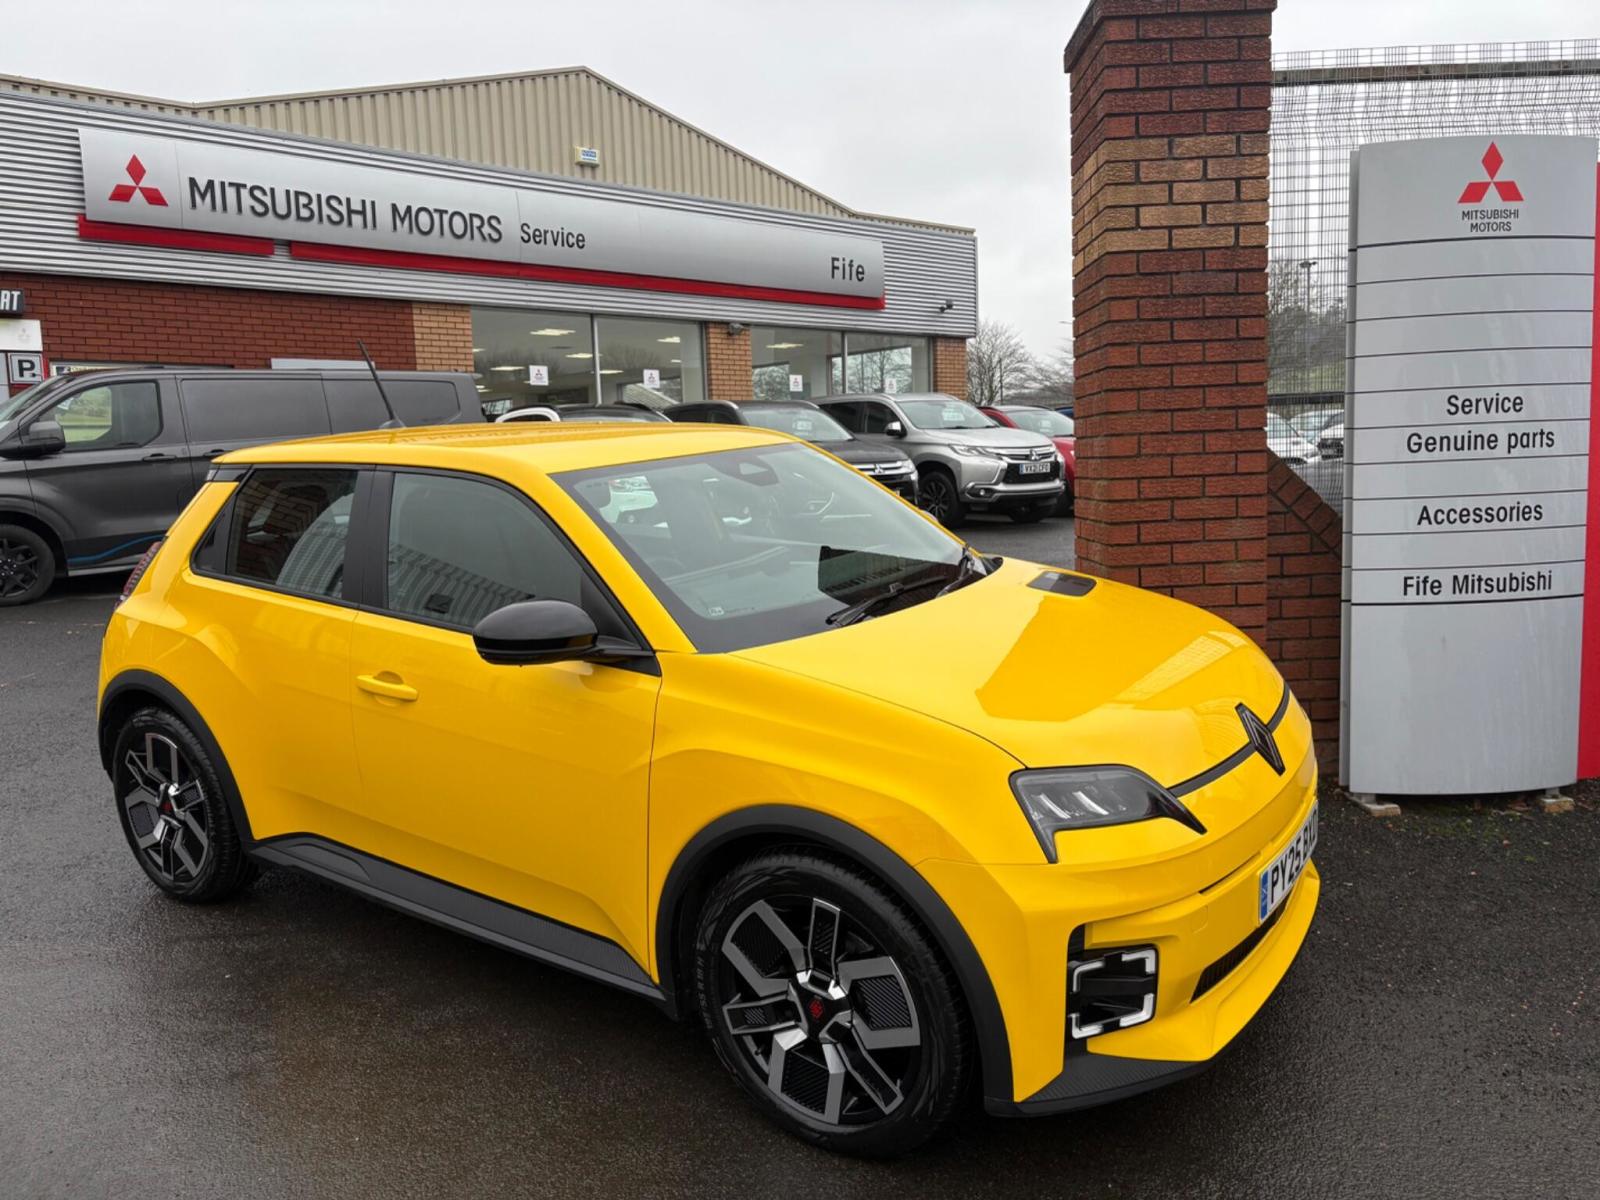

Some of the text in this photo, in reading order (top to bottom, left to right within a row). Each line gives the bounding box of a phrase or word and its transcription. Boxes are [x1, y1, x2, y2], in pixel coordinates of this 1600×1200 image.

[188, 177, 503, 244] MITSUBISHI MOTORS
[1461, 208, 1519, 220] MITSUBISHI
[520, 223, 586, 249] Service
[1470, 221, 1512, 232] MOTORS
[831, 257, 865, 282] Fife
[1446, 392, 1524, 416] Service
[1406, 428, 1555, 454] Genuine parts
[1416, 501, 1543, 525] Accessories
[1403, 570, 1553, 596] Fife Mitsubishi
[1271, 836, 1302, 904] PY25
